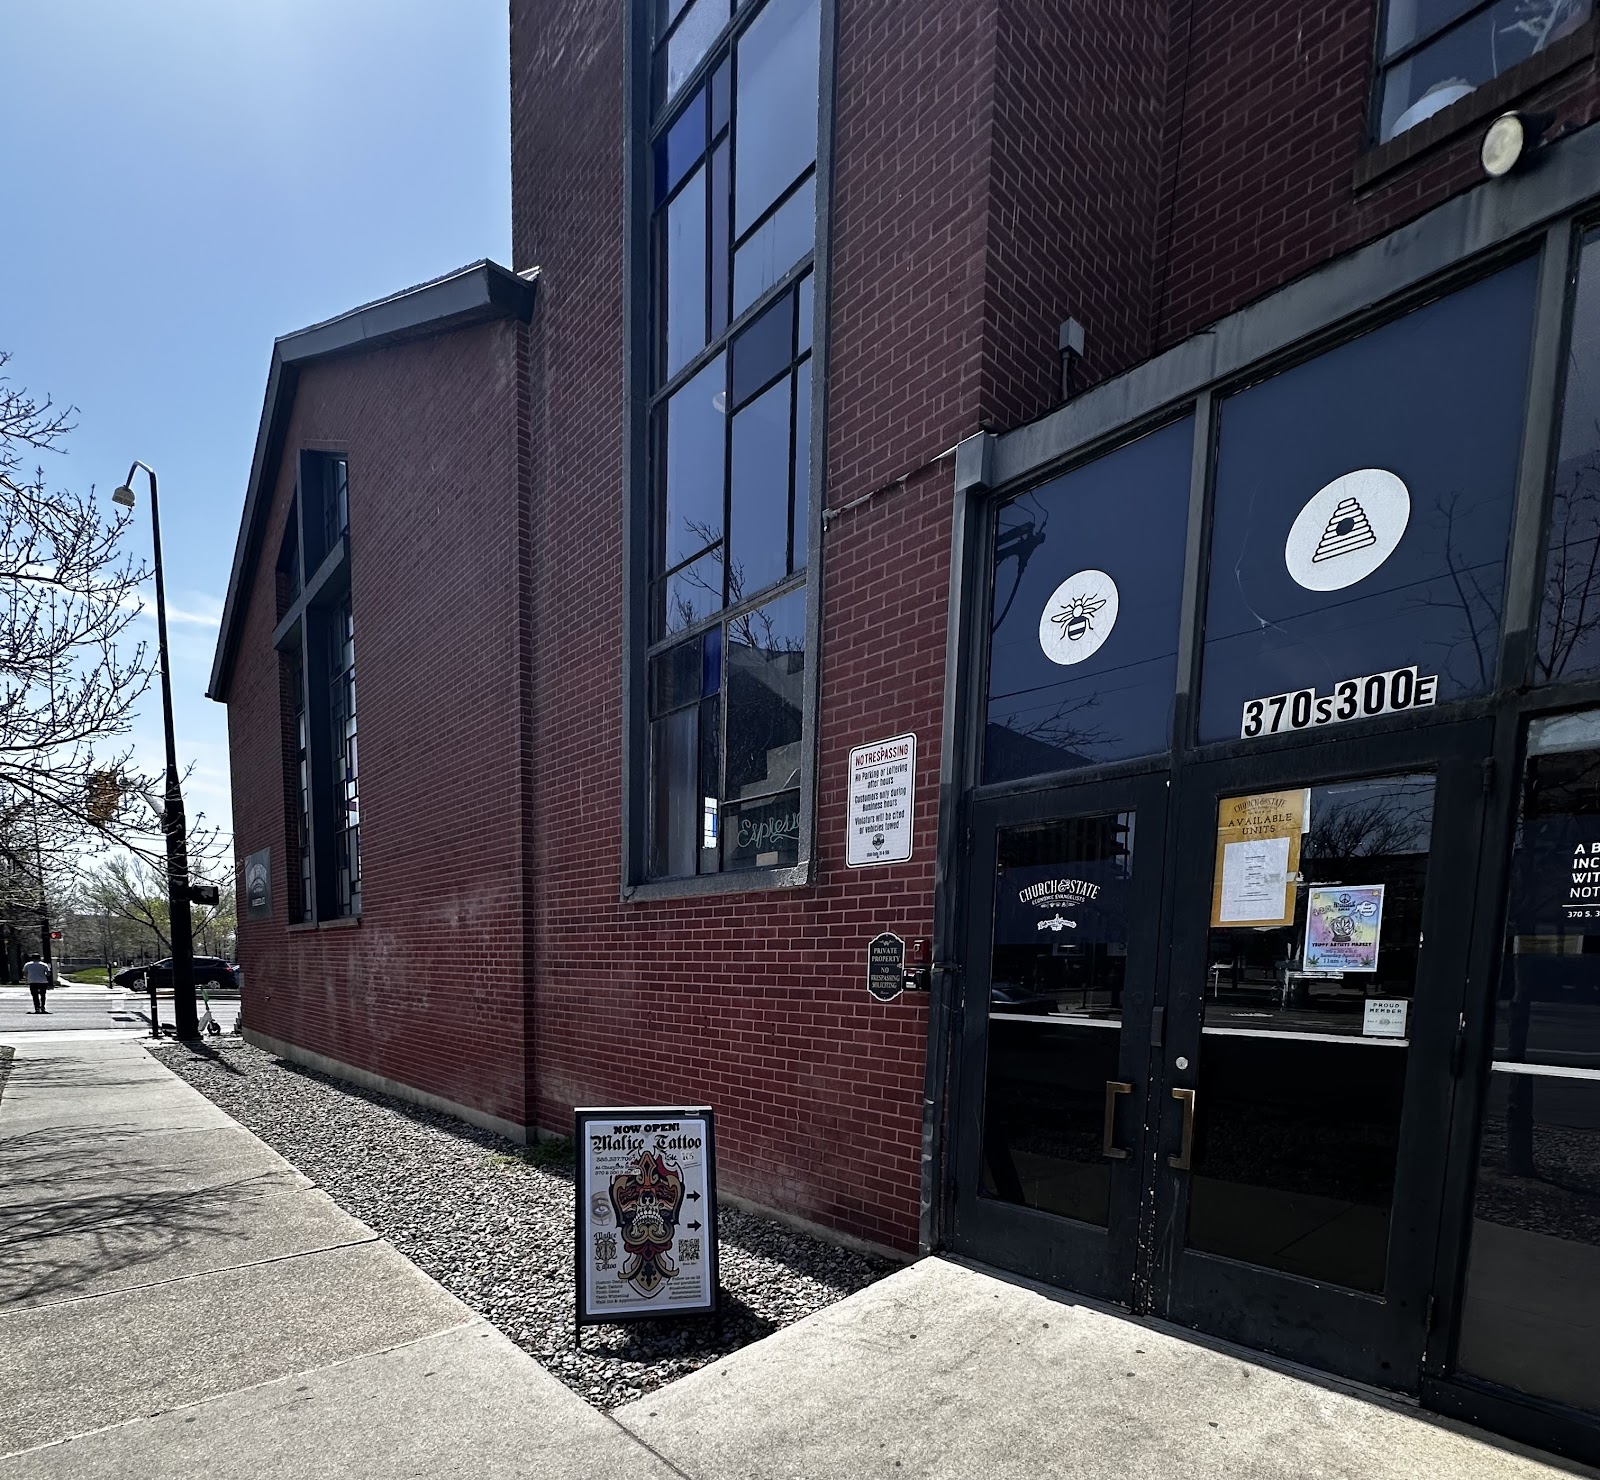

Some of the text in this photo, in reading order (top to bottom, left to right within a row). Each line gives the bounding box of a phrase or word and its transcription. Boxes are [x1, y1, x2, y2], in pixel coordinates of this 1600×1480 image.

[856, 744, 908, 766] NO TRESPASSING
[862, 769, 879, 780] Parking
[868, 776, 894, 788] after hours
[855, 792, 878, 804] Customers
[891, 787, 906, 798] during
[863, 798, 897, 812] Business hours
[855, 810, 905, 825] Violators will be cited
[1228, 813, 1292, 828] AVAILABLE
[865, 823, 884, 833] vehicles
[885, 820, 899, 830] towed
[1242, 825, 1276, 835] UNITS
[1574, 844, 1585, 854] A
[1019, 880, 1057, 903] CHURCH
[1069, 880, 1100, 899] STATE
[614, 1123, 680, 1134] NOW OPEN!
[590, 1134, 702, 1154] Malice Tattoo
